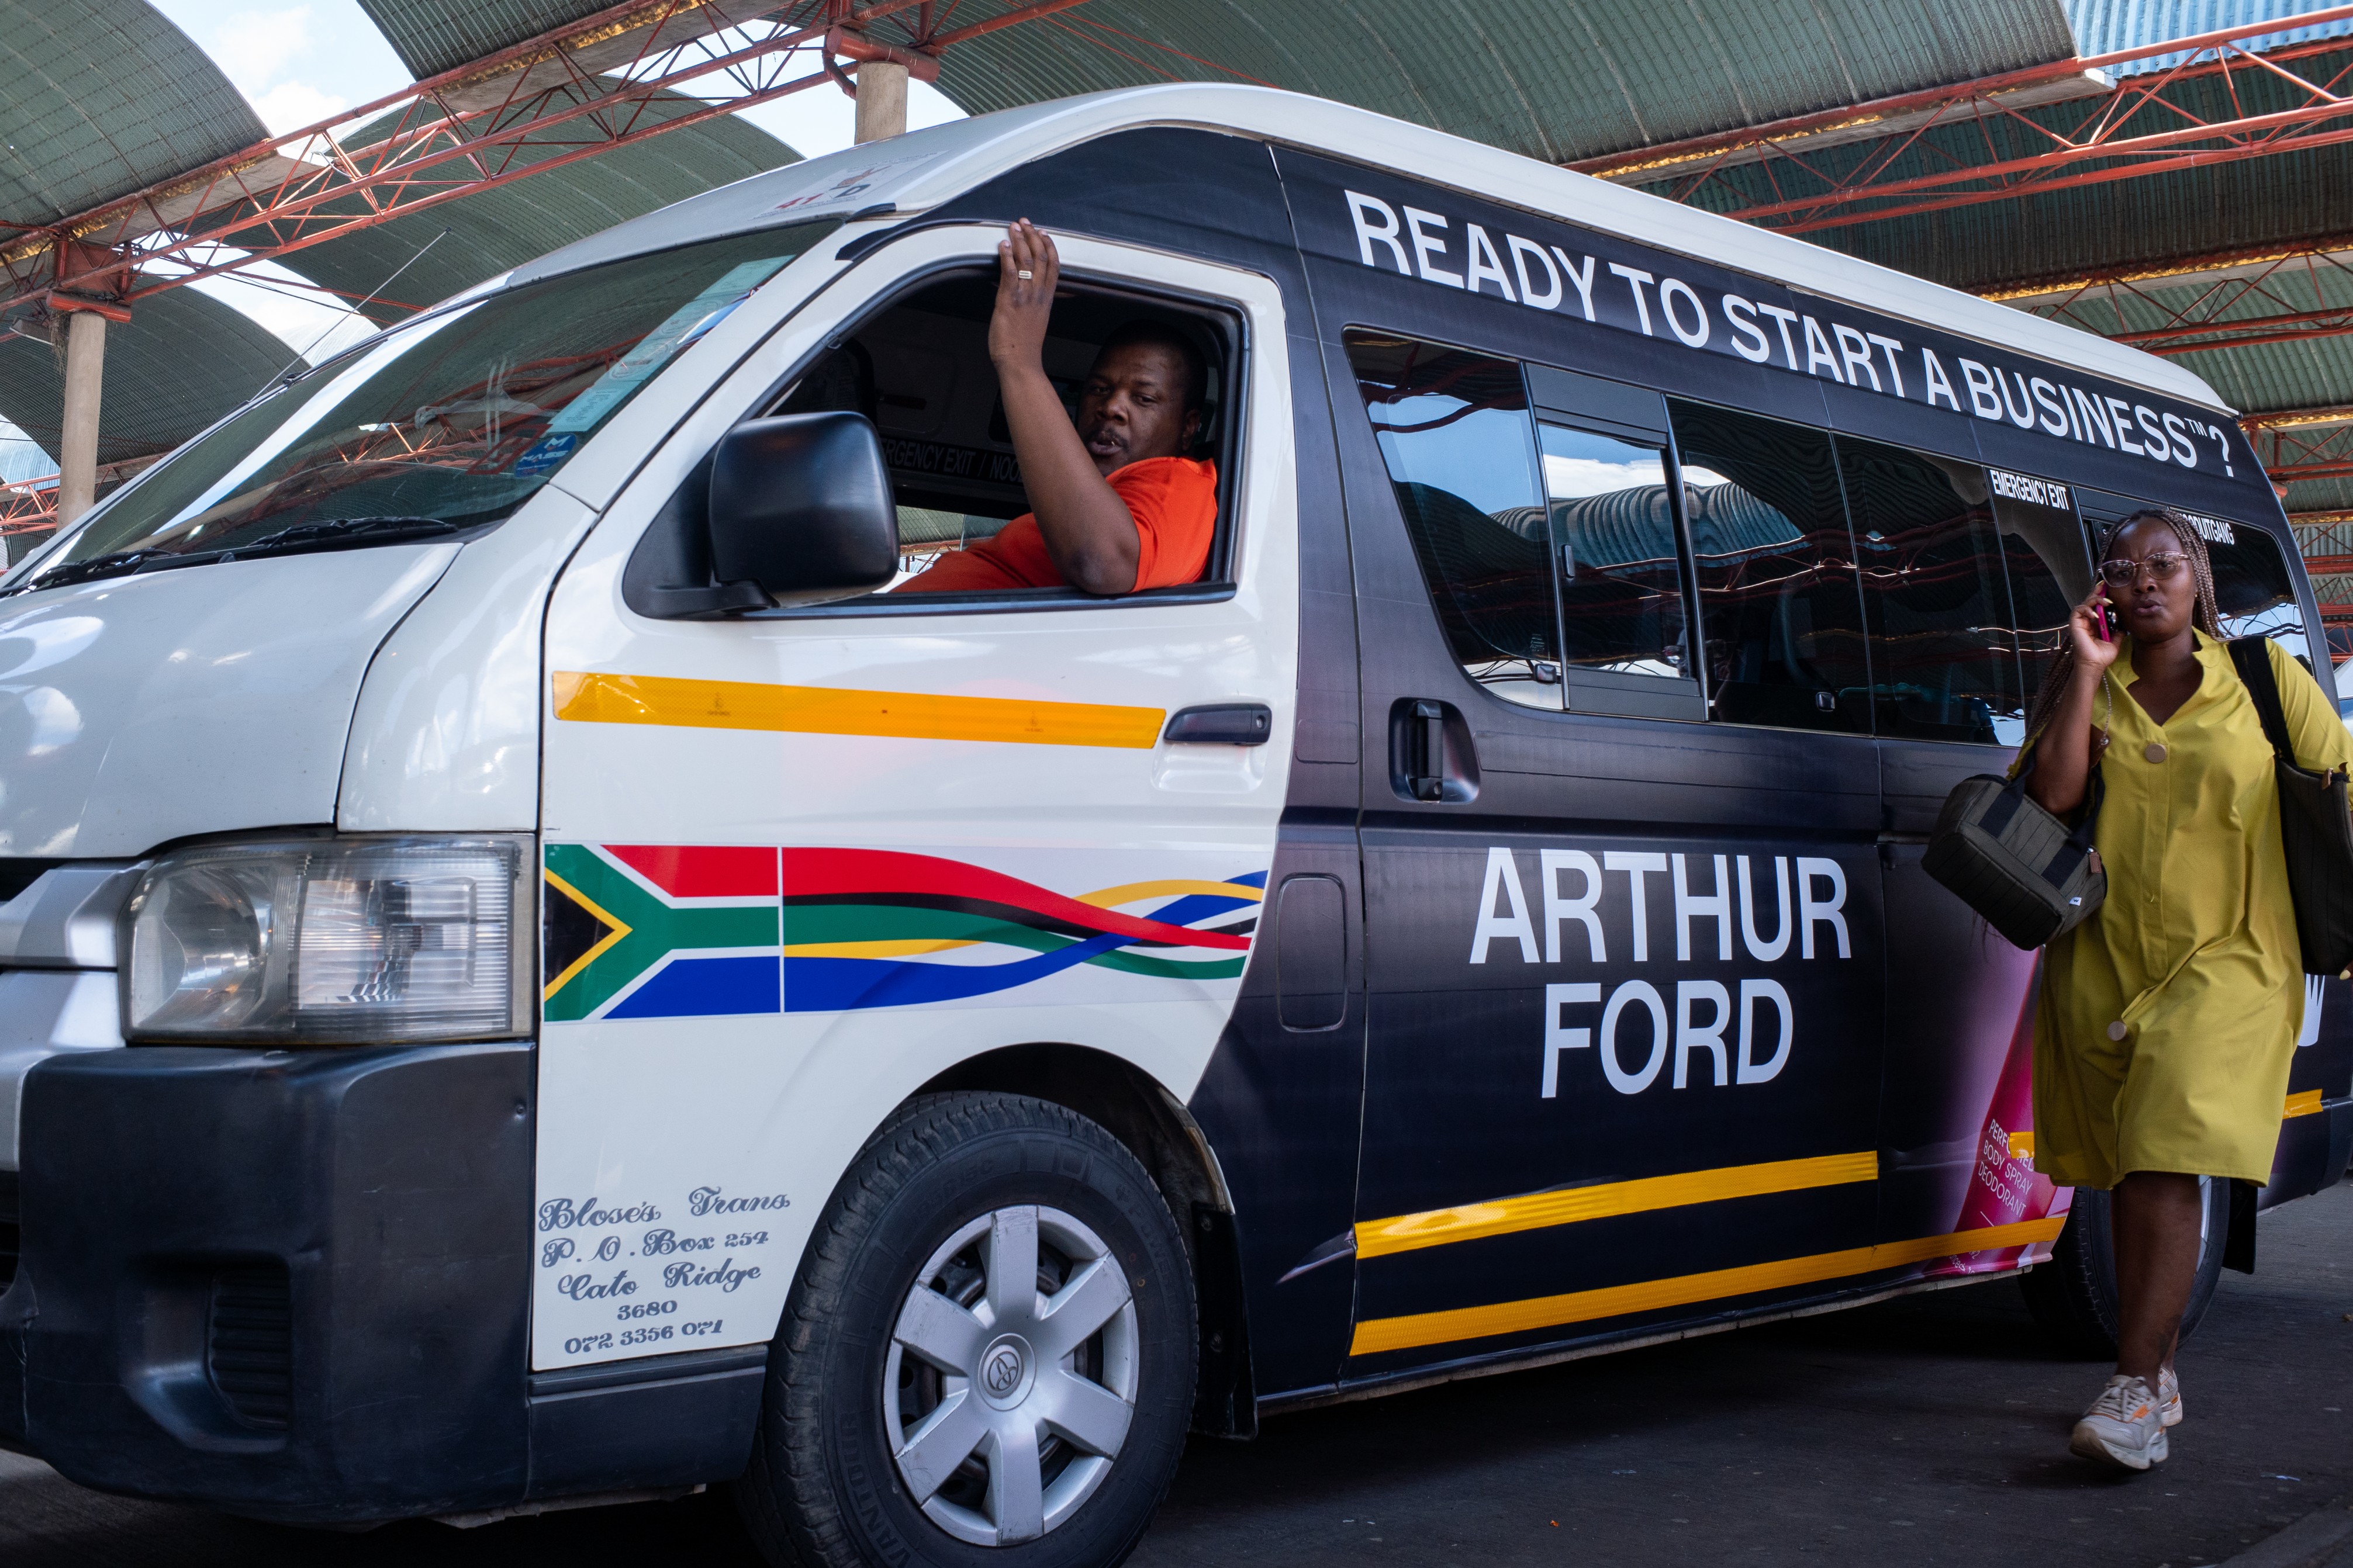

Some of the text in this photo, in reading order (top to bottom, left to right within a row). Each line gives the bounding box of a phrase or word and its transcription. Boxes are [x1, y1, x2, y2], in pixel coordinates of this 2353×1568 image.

[1345, 190, 1595, 321] READY
[1609, 262, 1709, 348] TO
[1723, 295, 1905, 397] START
[1922, 348, 1961, 411] A
[943, 448, 976, 475] EXIT
[1989, 469, 2069, 510] EMERGENCY EXIT
[1470, 847, 1851, 964] ARTHUR
[1542, 979, 1793, 1098] FORD
[1978, 1161, 2027, 1218] DEODORANT
[1984, 1140, 2033, 1196] BODY SPRAY
[538, 1186, 790, 1232] Blose's Trans
[642, 1228, 715, 1257] Box
[724, 1231, 769, 1247] 254
[557, 1258, 762, 1301] Cato Ridge
[617, 1300, 678, 1321] 3680
[564, 1319, 724, 1354] 072 3356 071
